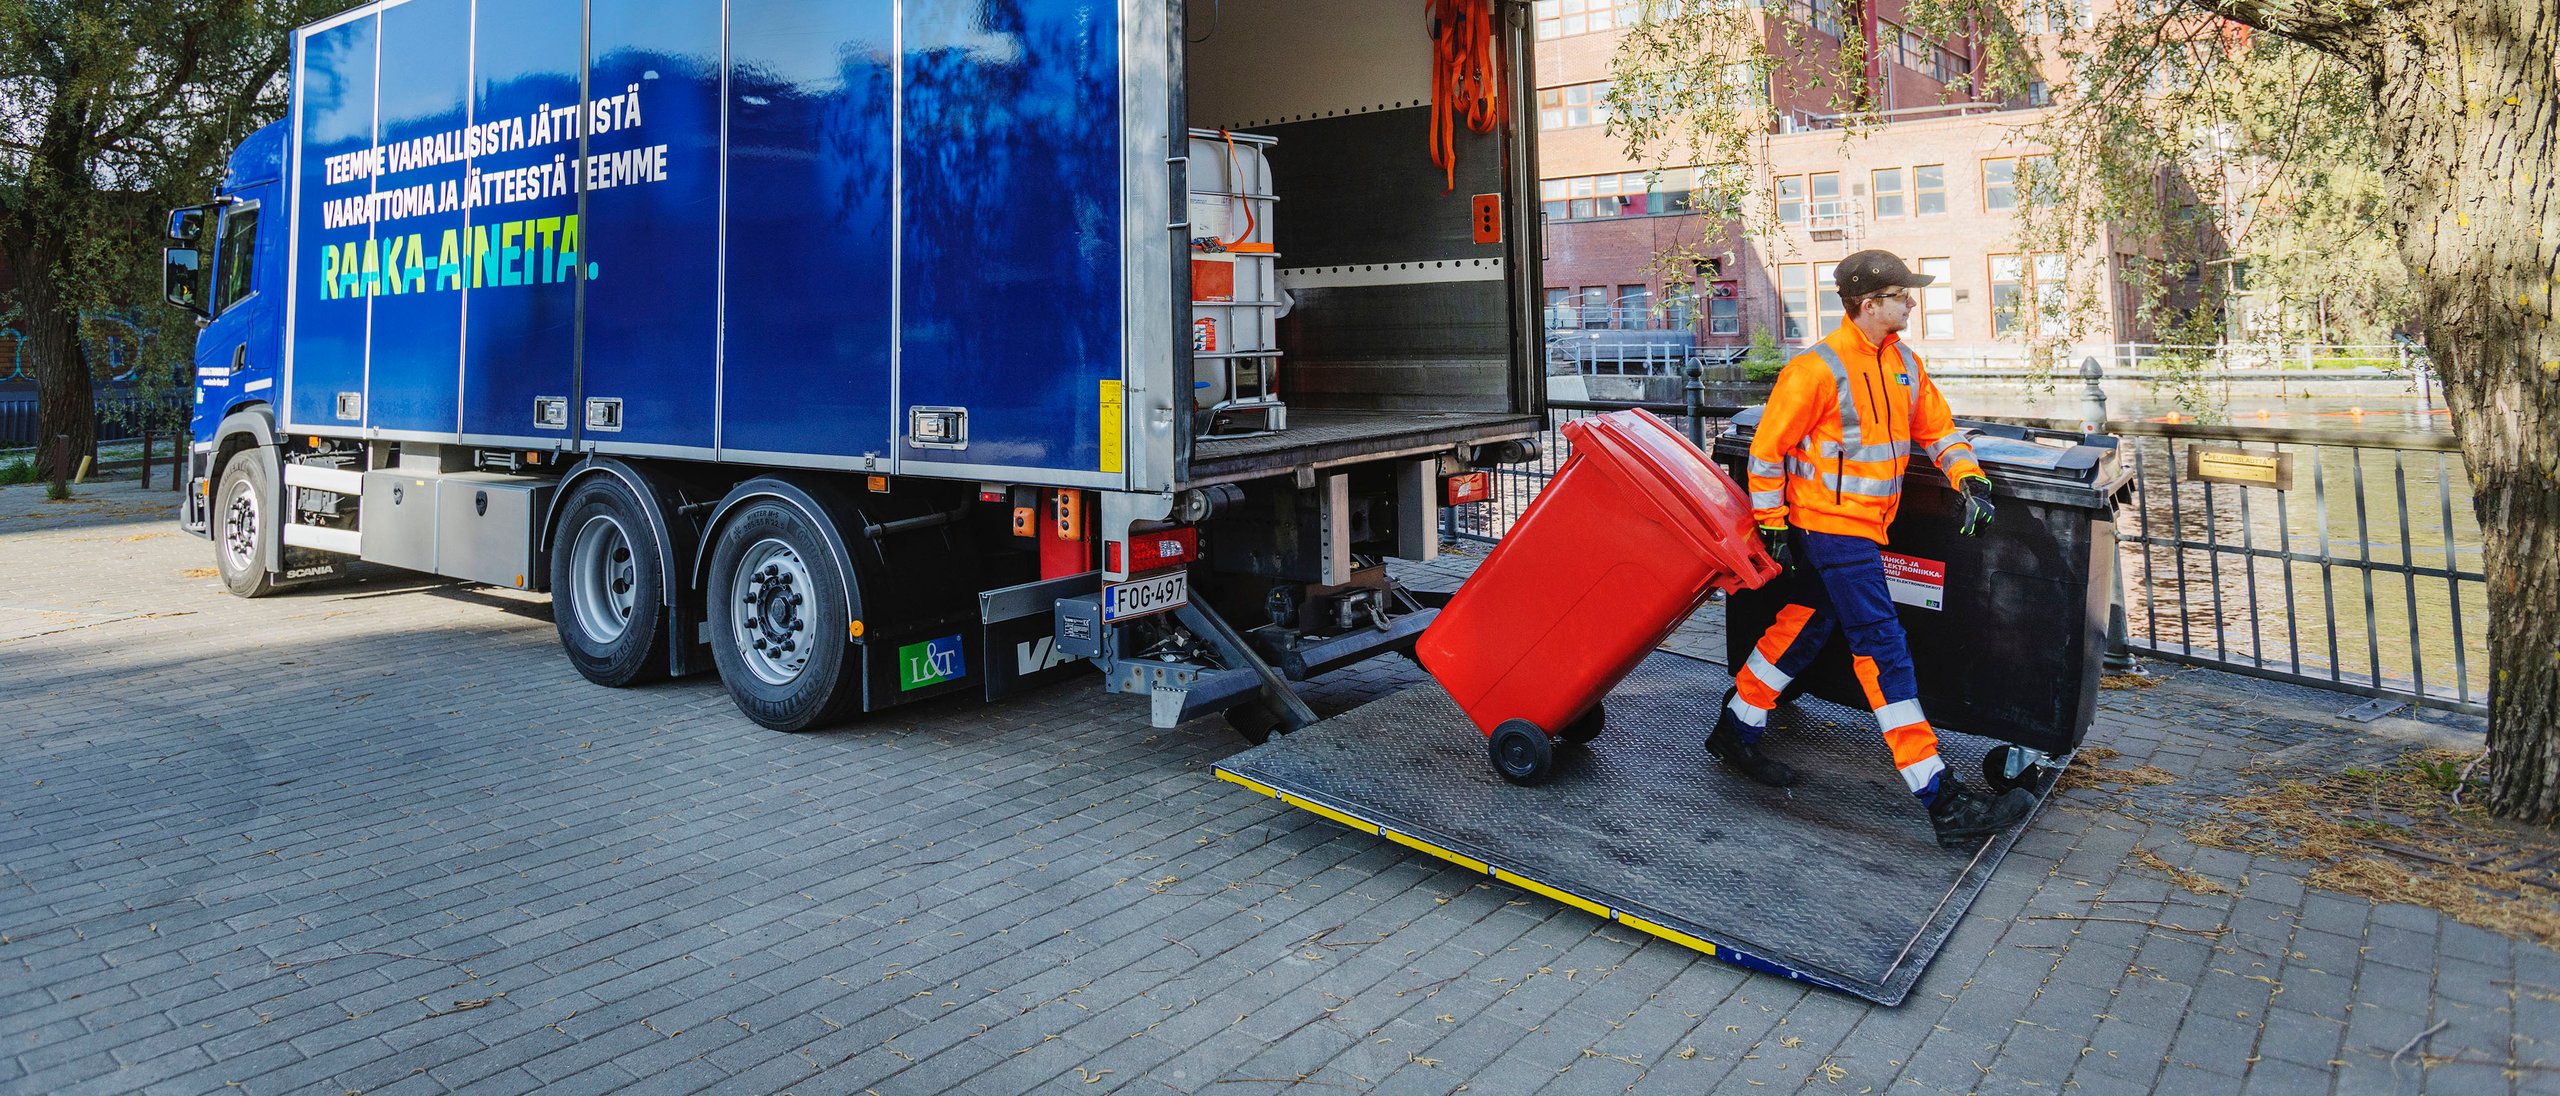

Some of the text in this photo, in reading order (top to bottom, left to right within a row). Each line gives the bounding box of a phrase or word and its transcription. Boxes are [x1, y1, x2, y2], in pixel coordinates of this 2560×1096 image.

[325, 145, 386, 186] TEEMME
[389, 116, 524, 173] VAARALLISISTA
[323, 144, 668, 230] VAARATTOMIA JA JÄTTEESTÄ TEEMME
[320, 214, 599, 300] RAAKA-AINEITA.
[286, 565, 334, 579] SCANIA
[1883, 562, 1942, 578] LEKTRONIIKKA-
[1884, 568, 1900, 577] OMU
[1105, 577, 1183, 614] FIN FOG-497
[910, 642, 956, 684] L&T
[1017, 636, 1088, 676] VA
